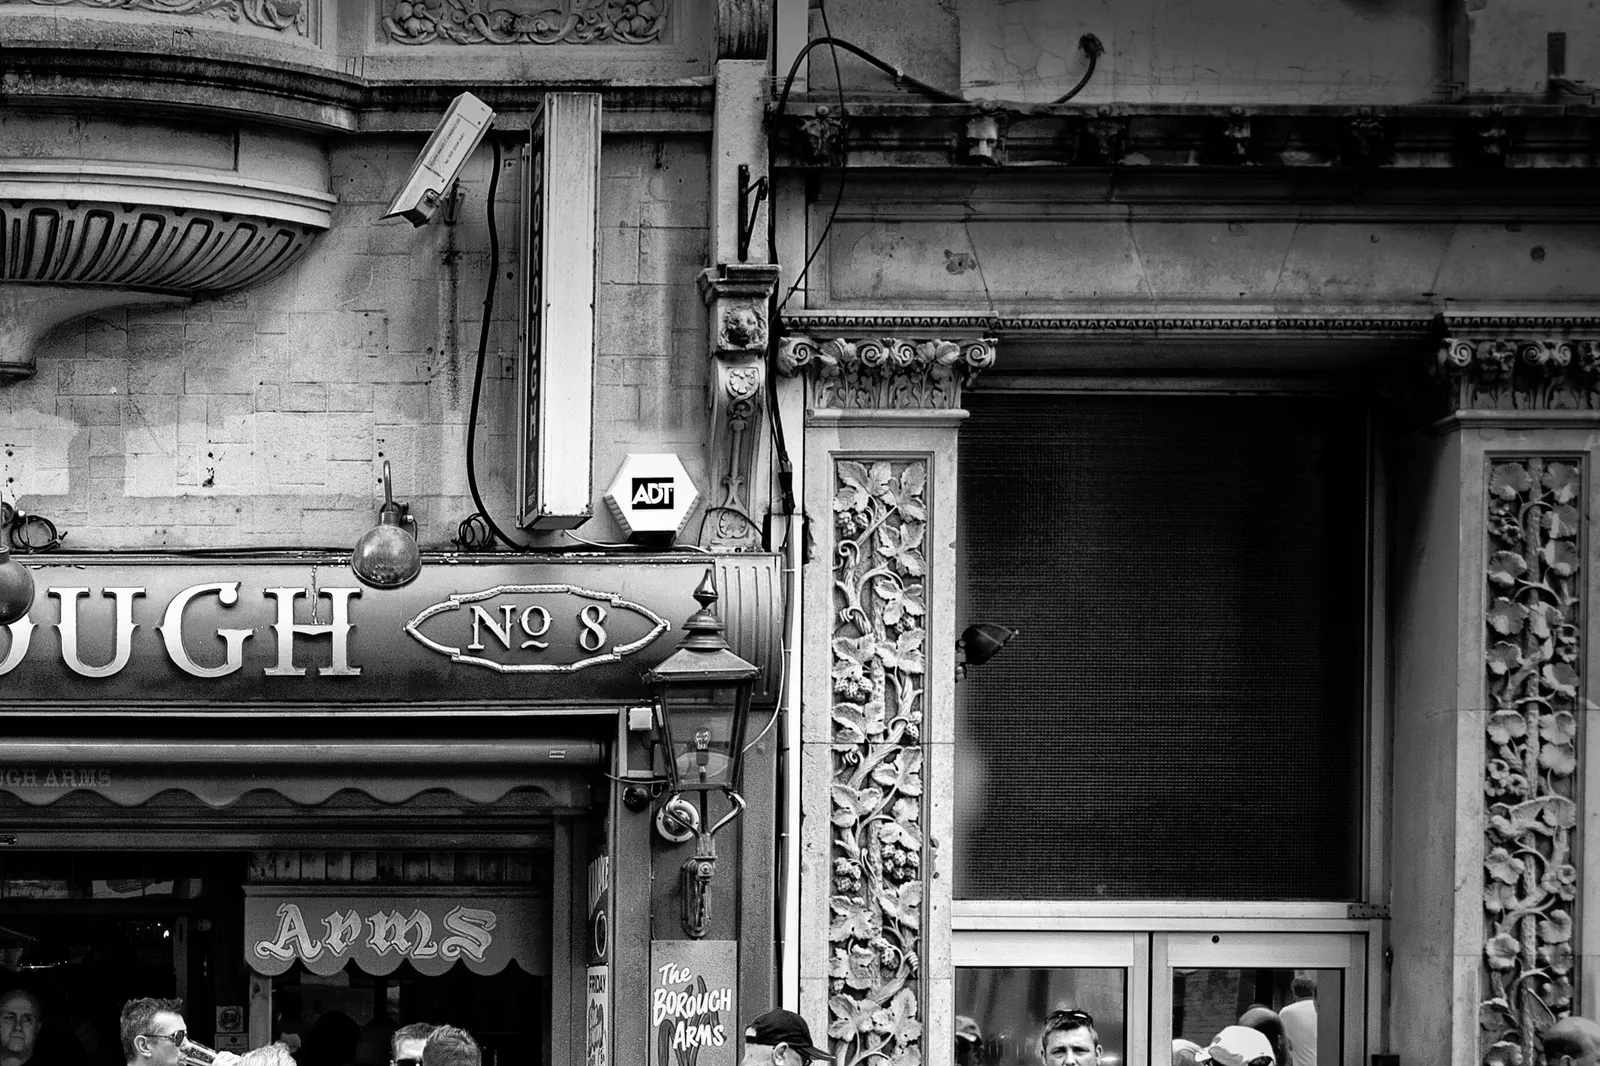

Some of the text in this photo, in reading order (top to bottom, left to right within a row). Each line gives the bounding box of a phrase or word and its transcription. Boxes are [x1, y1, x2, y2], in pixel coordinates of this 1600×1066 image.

[529, 151, 542, 441] BOROUGH
[632, 483, 674, 505] ADT
[578, 604, 608, 652] 8
[44, 768, 112, 787] ARMS
[659, 962, 693, 986] The
[652, 988, 732, 1027] BOROUGH
[673, 1020, 724, 1051] ARMS
